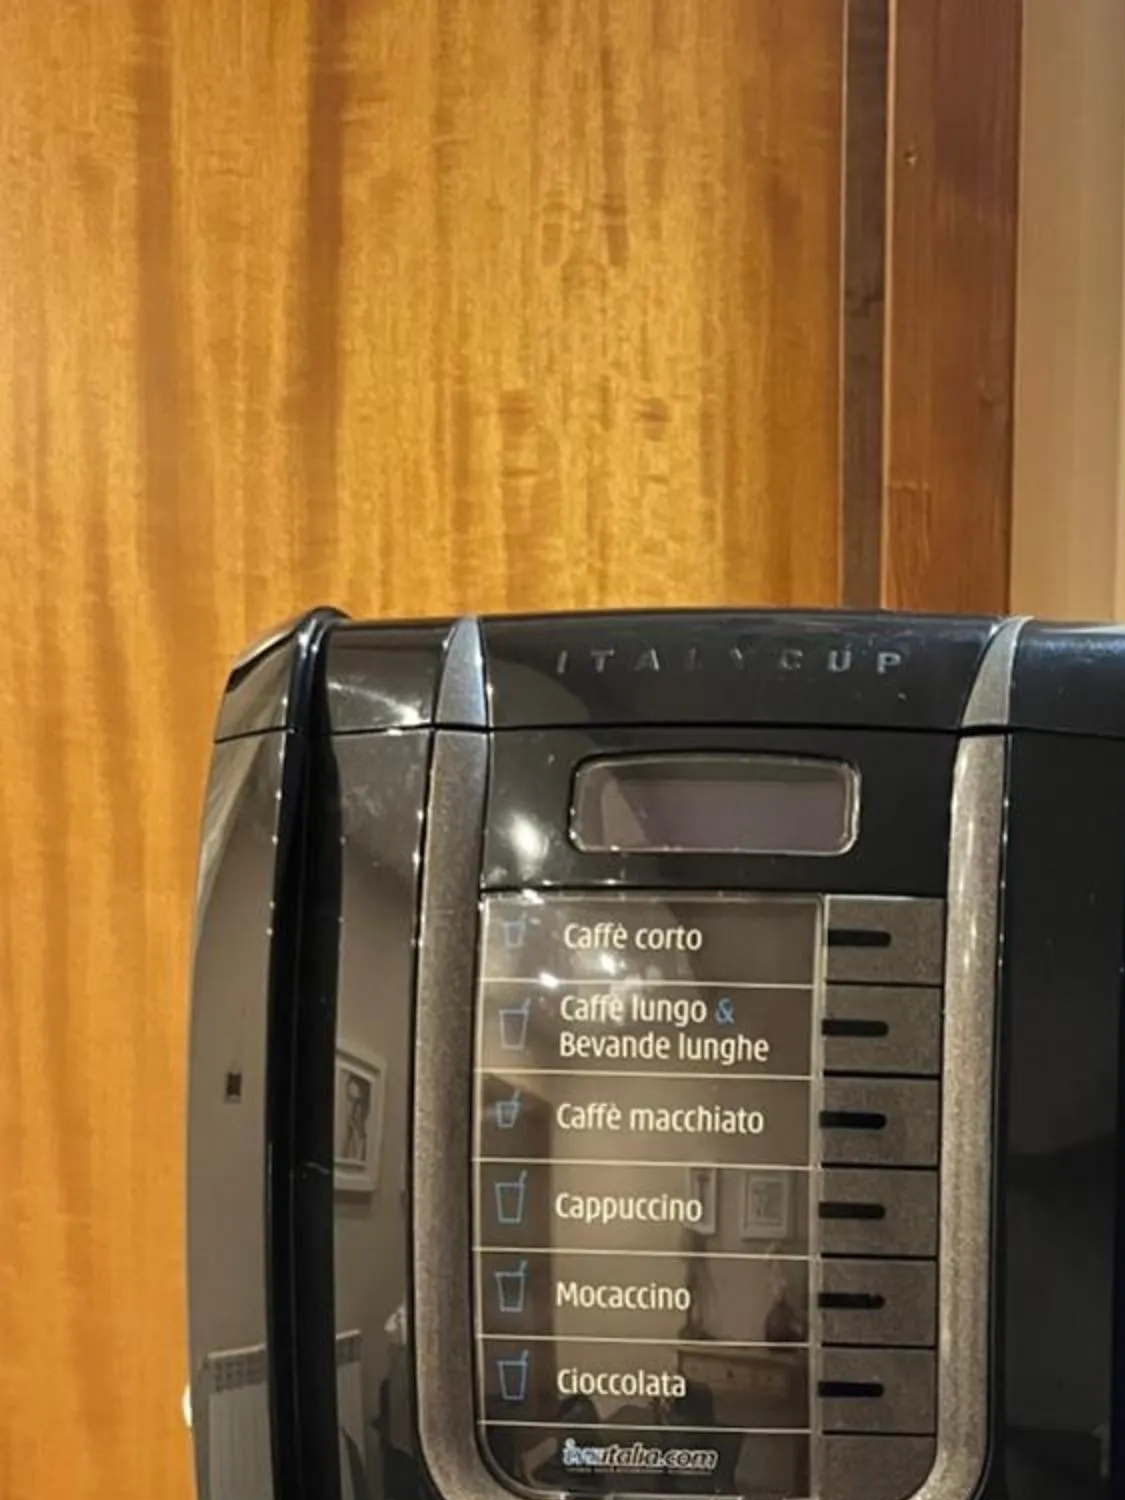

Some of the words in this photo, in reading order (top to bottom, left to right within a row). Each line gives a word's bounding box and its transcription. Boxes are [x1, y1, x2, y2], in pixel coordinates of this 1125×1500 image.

[563, 921, 629, 951] Caffè
[635, 925, 703, 952] corto
[560, 994, 624, 1023] Caffè
[631, 995, 707, 1027] lungo
[715, 998, 736, 1024] &
[559, 1031, 671, 1060] Bevande
[678, 1032, 770, 1065] lunghe
[556, 1103, 622, 1130] Caffè
[629, 1104, 765, 1135] macchiato
[555, 1191, 703, 1223] Cappuccino
[556, 1281, 692, 1312] Mocaccino
[556, 1367, 687, 1398] Cioccolata
